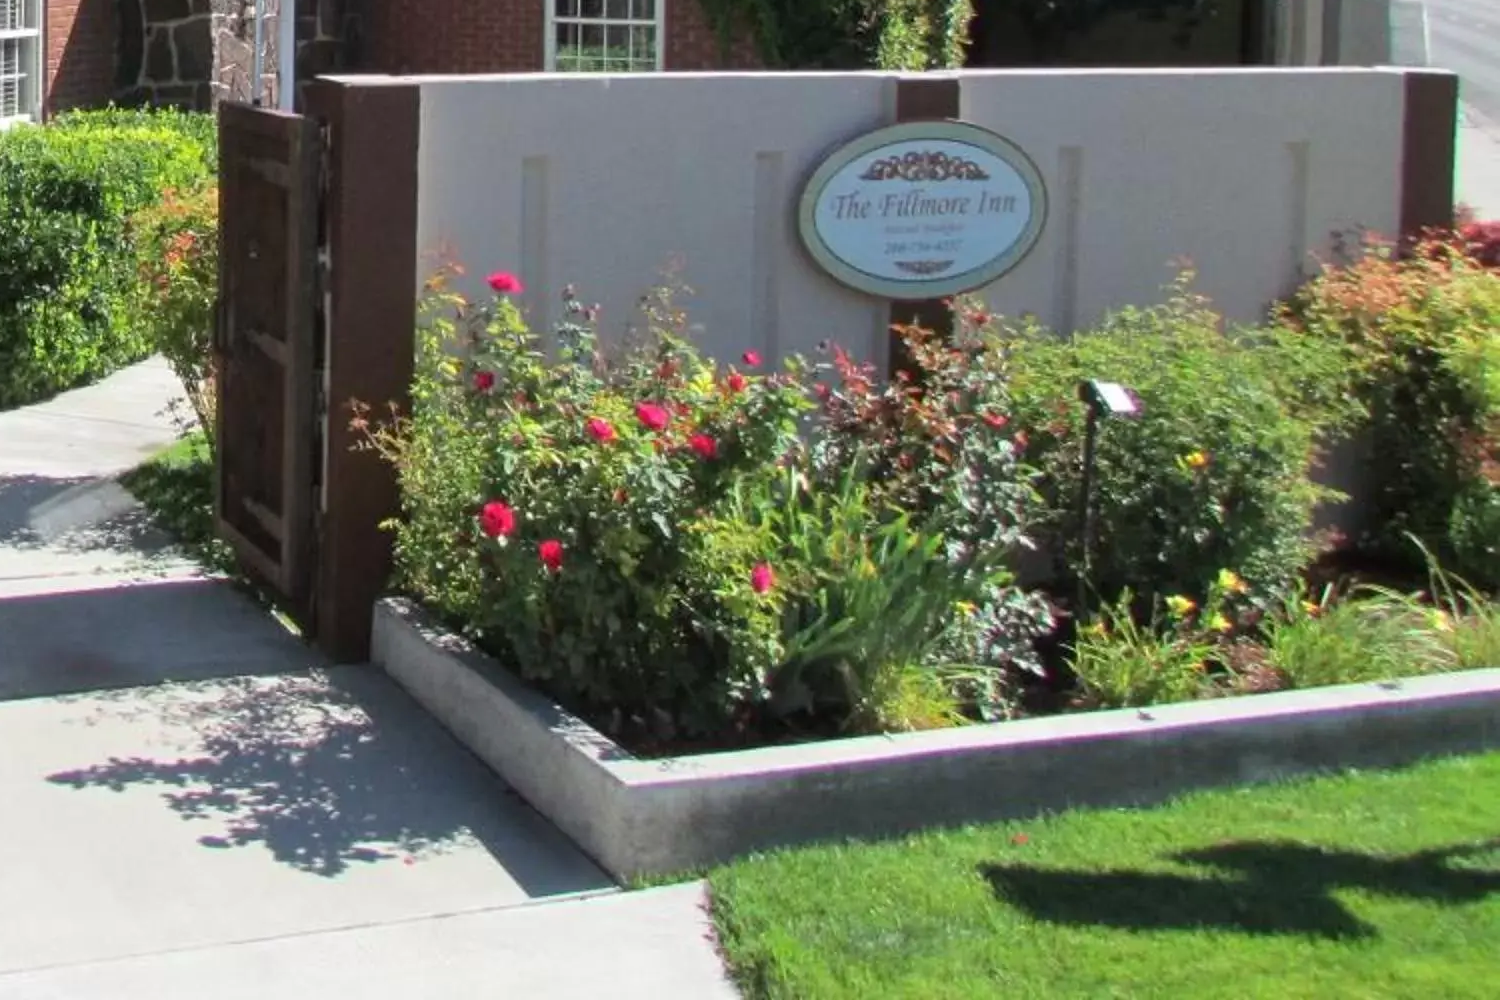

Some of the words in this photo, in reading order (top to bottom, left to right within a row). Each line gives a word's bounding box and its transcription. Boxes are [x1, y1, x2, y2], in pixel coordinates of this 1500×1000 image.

[833, 190, 872, 220] The
[877, 189, 969, 218] Fillmore
[977, 190, 1018, 214] Inn
